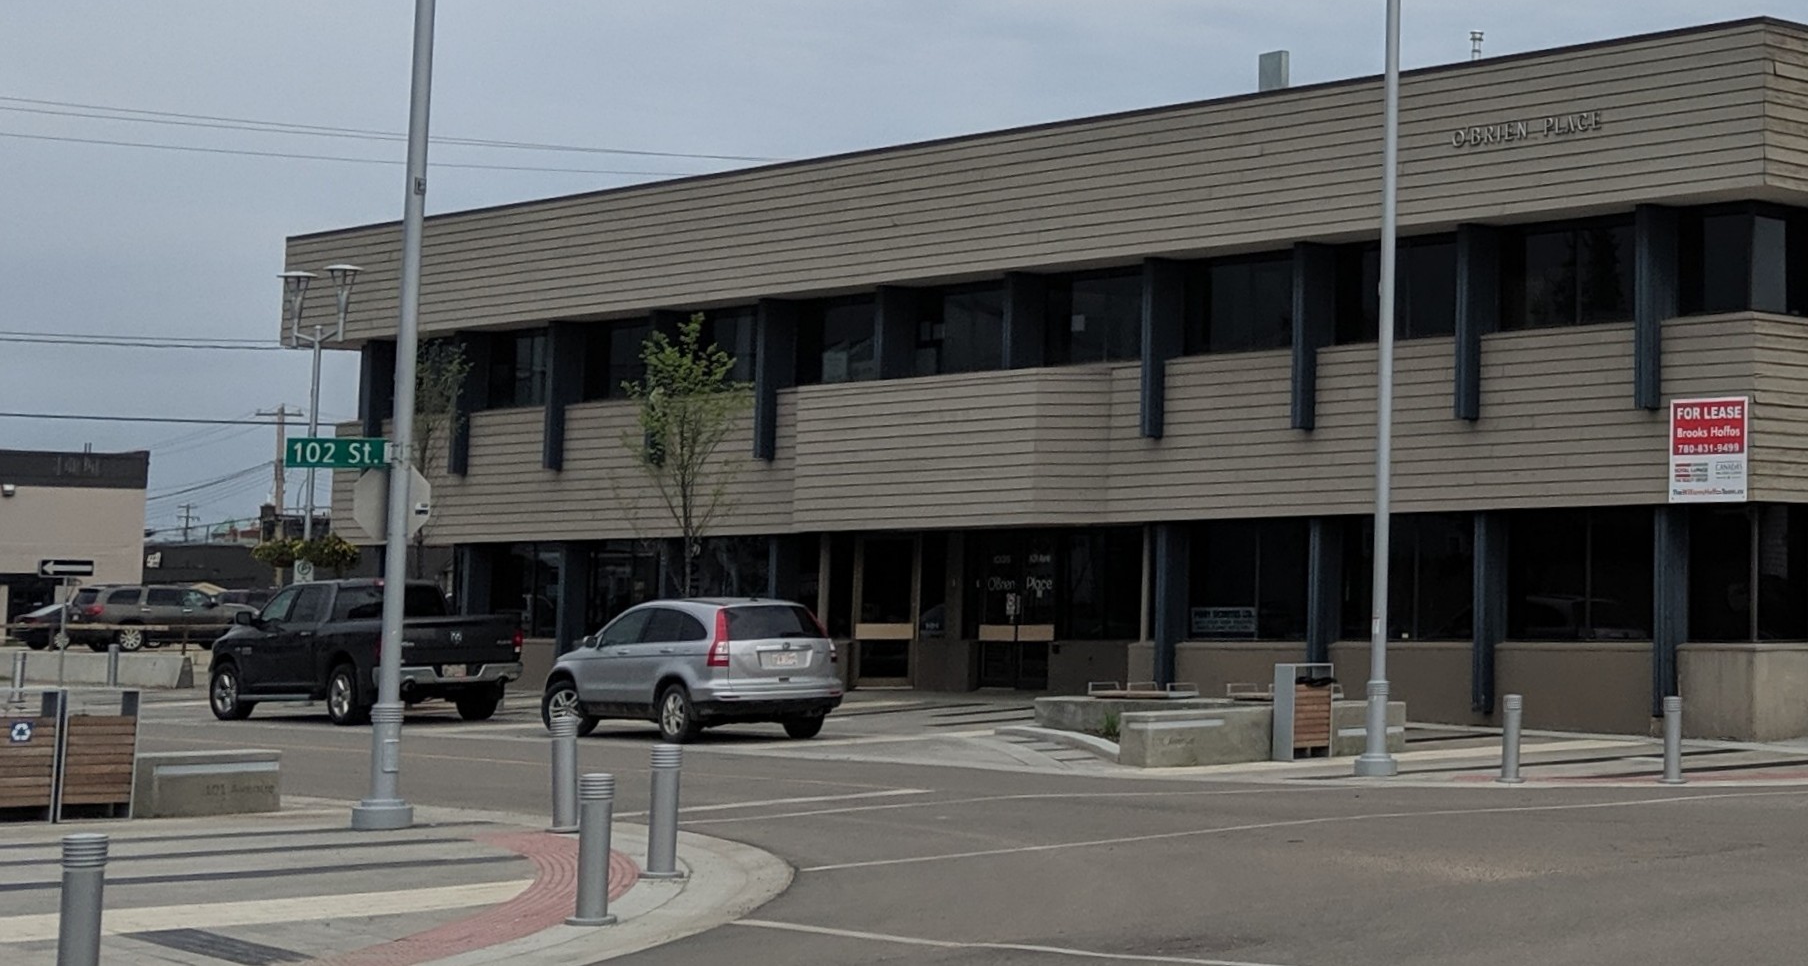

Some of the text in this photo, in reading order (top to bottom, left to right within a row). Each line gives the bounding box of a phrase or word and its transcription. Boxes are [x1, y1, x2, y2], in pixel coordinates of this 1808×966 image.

[1543, 112, 1602, 137] PLACE
[1677, 406, 1742, 420] FOR LEASE
[1677, 425, 1741, 438] Brooks Hoffos
[293, 442, 379, 463] 102 St.
[1026, 576, 1053, 591] Place
